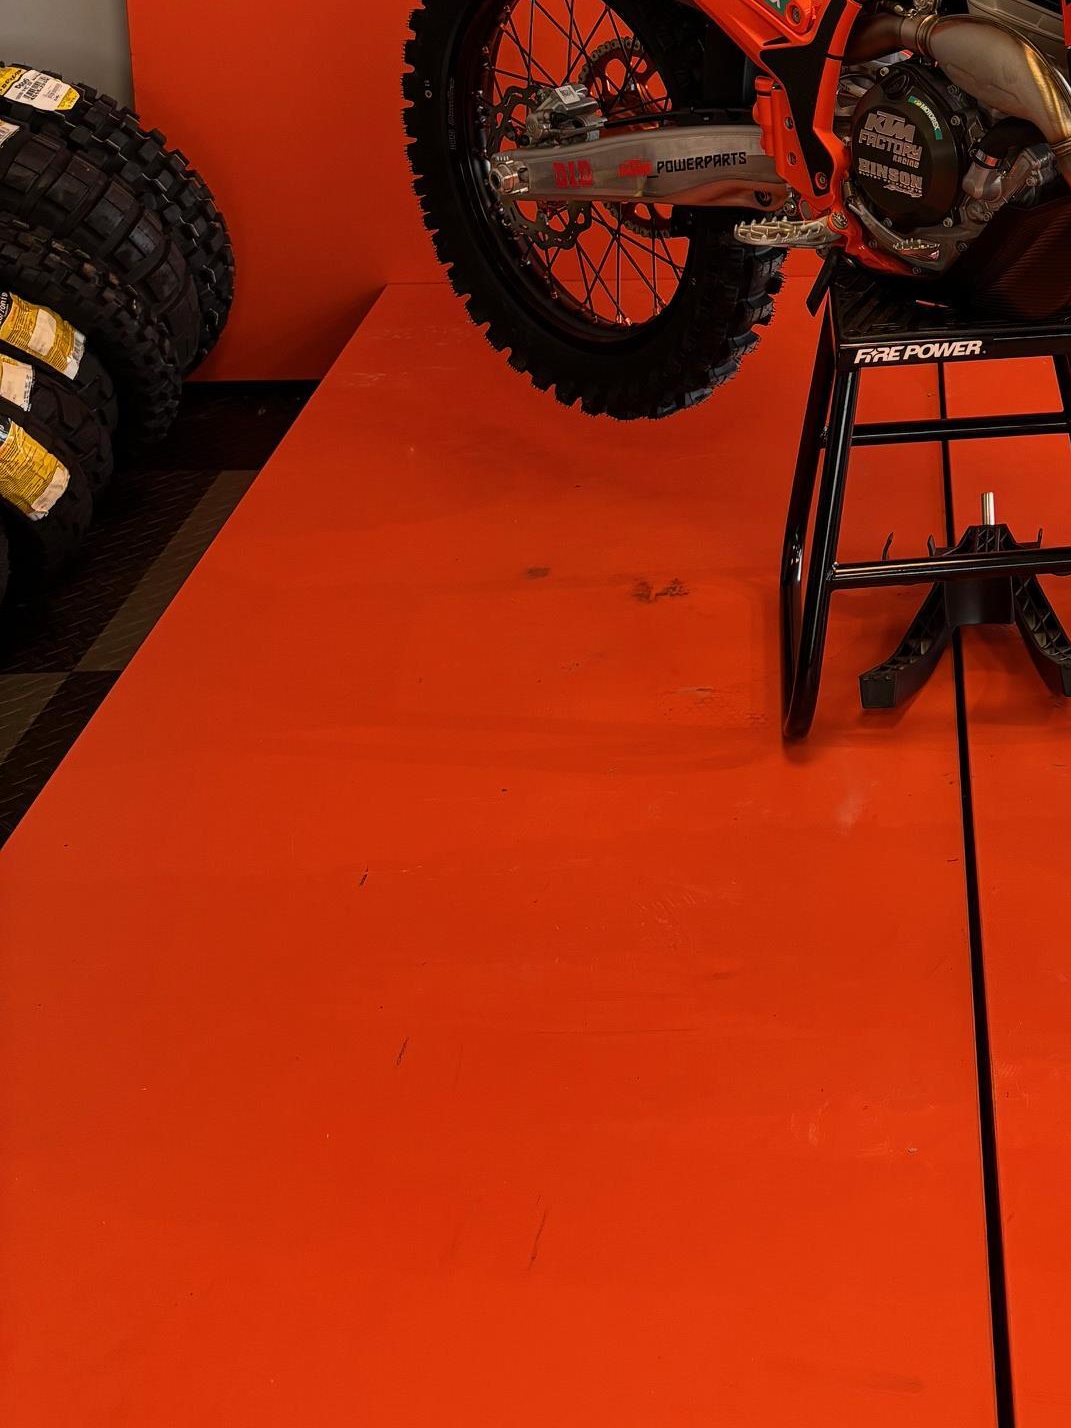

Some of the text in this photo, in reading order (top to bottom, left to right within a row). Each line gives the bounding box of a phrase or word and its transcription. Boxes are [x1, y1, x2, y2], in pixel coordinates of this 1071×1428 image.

[864, 110, 916, 143] KTM
[858, 129, 923, 162] FACTORY
[656, 151, 747, 174] POWERPARTS
[858, 157, 923, 190] HINSON
[853, 340, 983, 364] FIRE POWER
